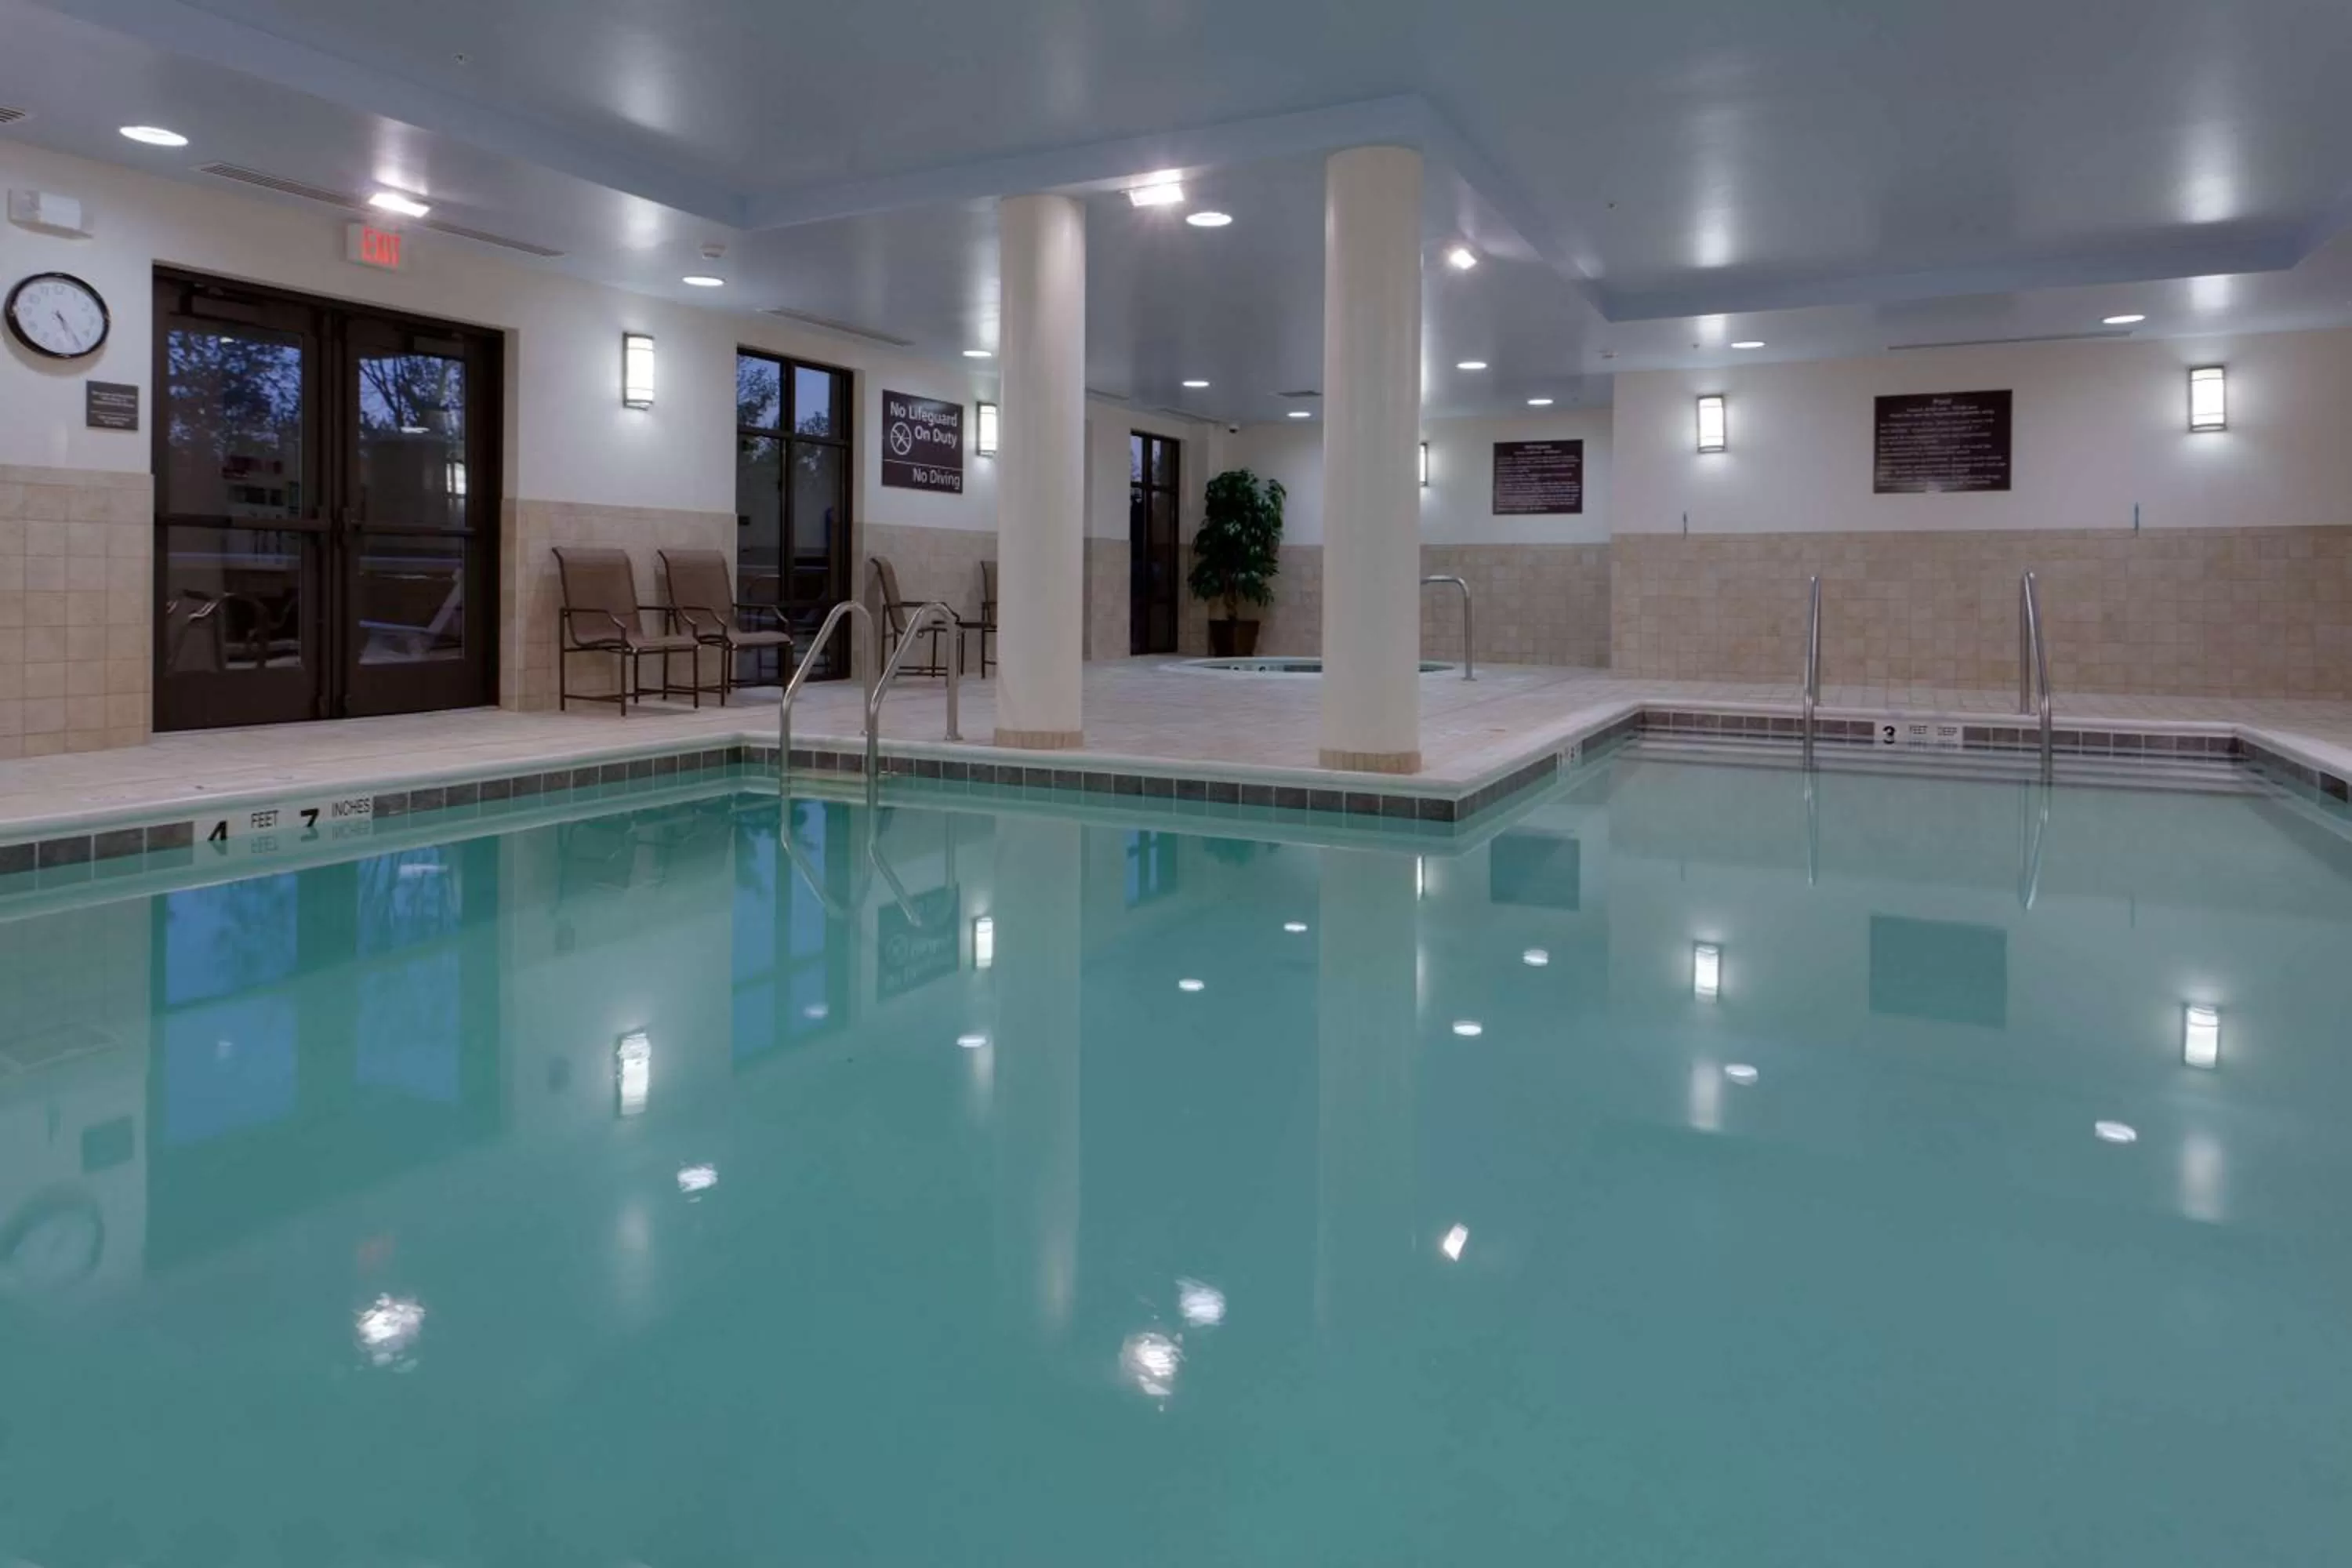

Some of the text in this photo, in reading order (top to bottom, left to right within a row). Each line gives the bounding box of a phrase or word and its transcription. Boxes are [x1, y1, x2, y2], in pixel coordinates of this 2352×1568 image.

[362, 225, 401, 268] EXIT
[890, 401, 957, 427] No Lifeguard
[914, 425, 957, 449] On Duty
[913, 467, 960, 490] No Diving
[250, 810, 279, 829] FEET
[300, 808, 320, 828] 7
[332, 797, 371, 818] INCHES
